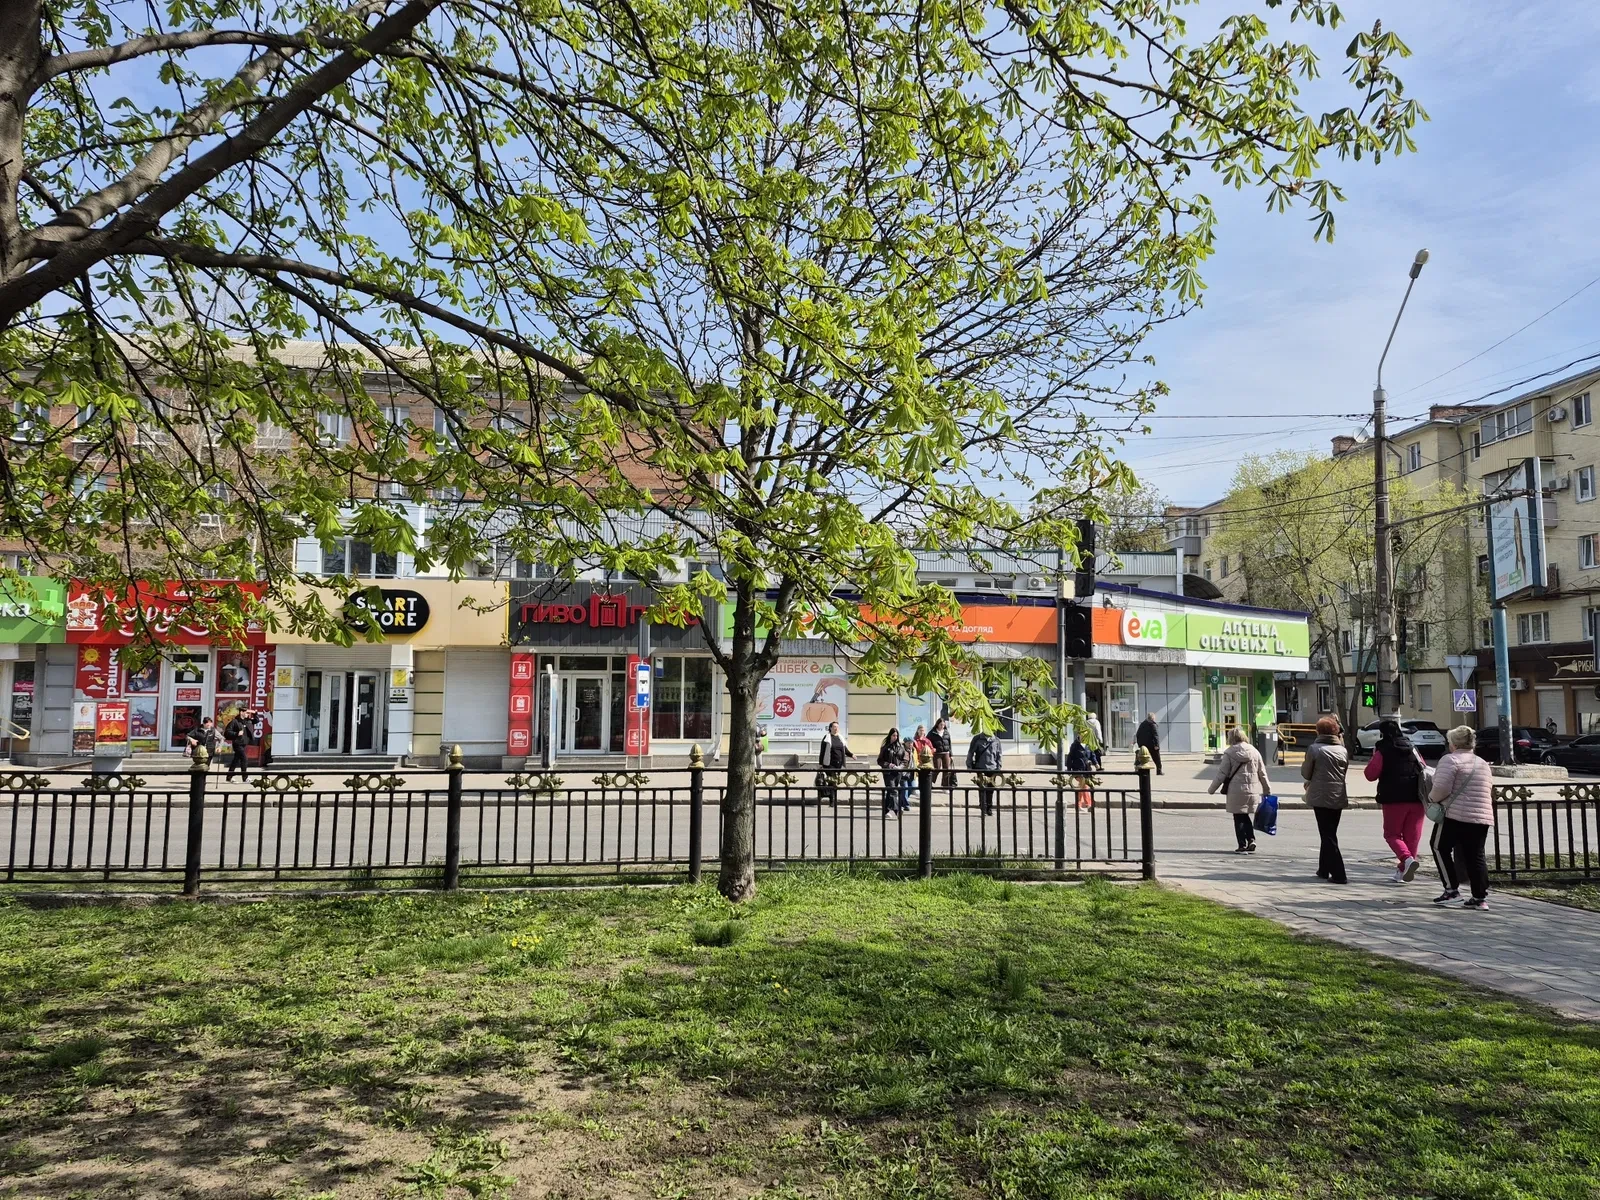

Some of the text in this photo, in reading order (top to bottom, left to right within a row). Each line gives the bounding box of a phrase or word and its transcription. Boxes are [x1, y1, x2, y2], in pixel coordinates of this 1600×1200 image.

[0, 602, 31, 617] ка
[1222, 621, 1278, 638] АПТЕКА
[1200, 635, 1268, 653] ОПТОВИХ
[768, 664, 808, 673] ЕШБЕК
[1577, 660, 1594, 672] РИБН
[107, 648, 119, 699] рашок
[1364, 684, 1375, 692] 31
[776, 702, 793, 713] 25%
